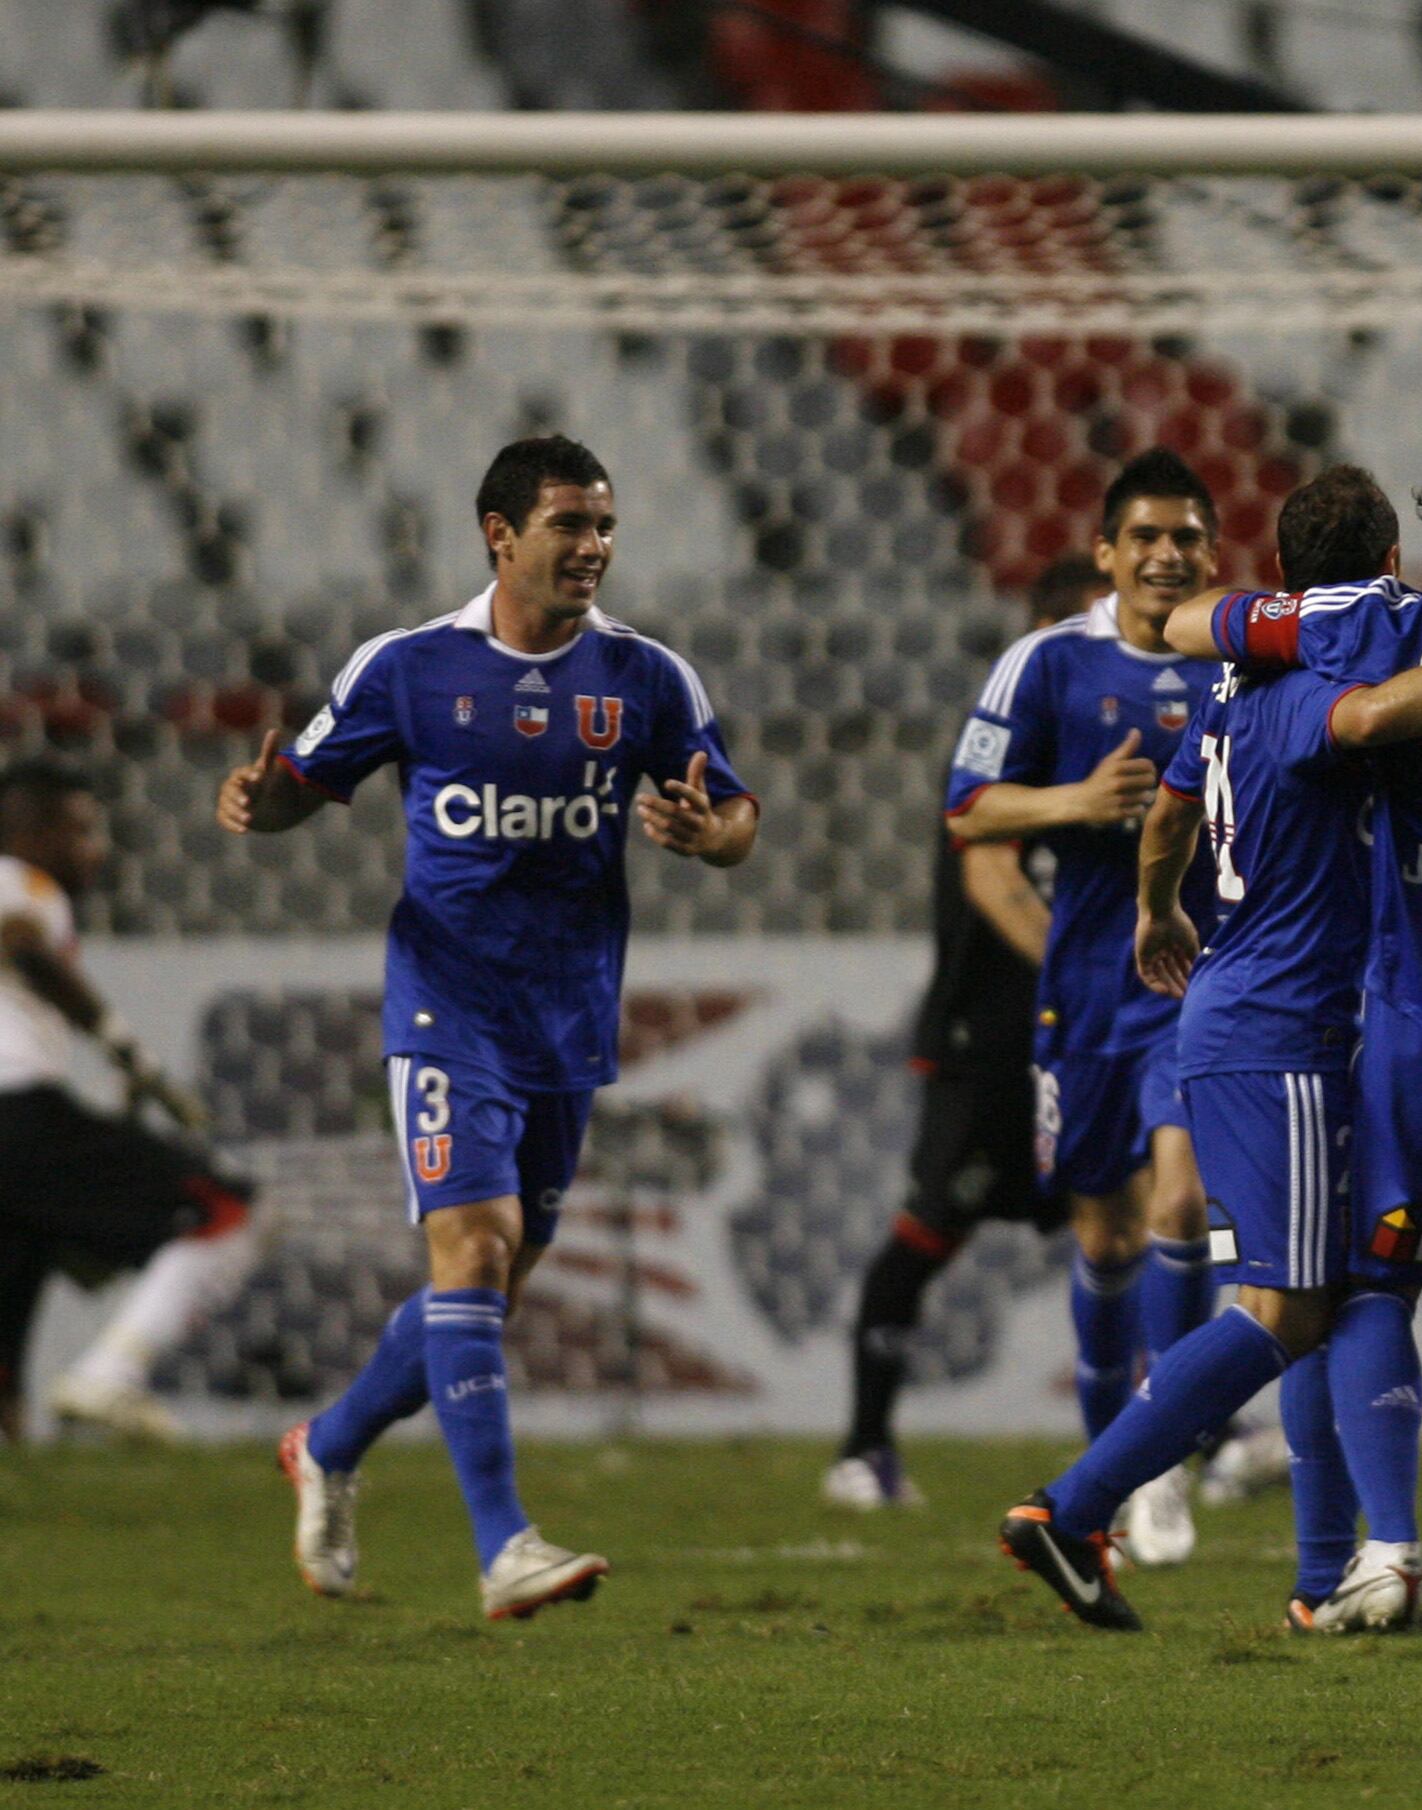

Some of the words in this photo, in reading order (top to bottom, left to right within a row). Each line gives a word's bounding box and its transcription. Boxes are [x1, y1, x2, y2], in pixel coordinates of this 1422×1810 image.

[575, 694, 623, 750] U
[434, 781, 600, 839] Claro
[416, 1066, 450, 1133] 3
[414, 1133, 453, 1182] U
